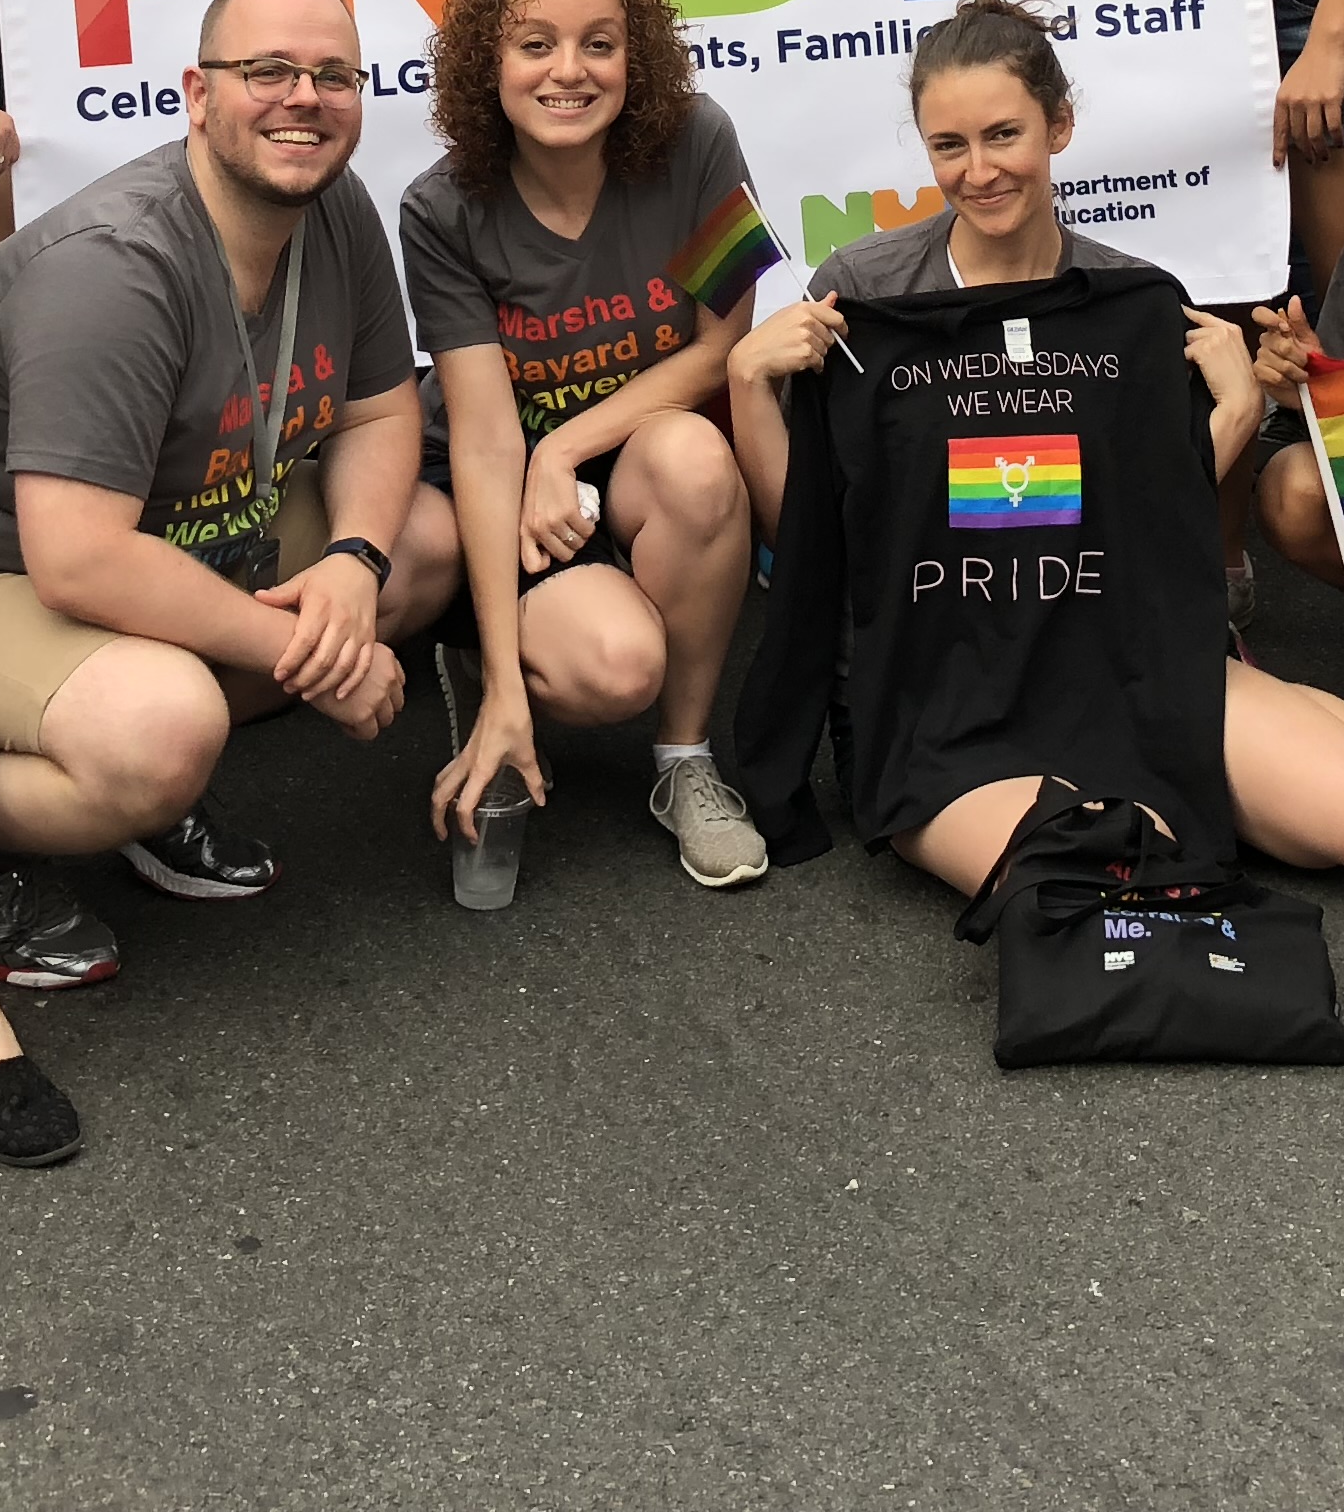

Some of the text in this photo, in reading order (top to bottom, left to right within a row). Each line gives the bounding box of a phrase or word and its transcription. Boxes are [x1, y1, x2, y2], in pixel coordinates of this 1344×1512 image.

[1185, 166, 1210, 187] of
[1055, 201, 1155, 226] ucation
[498, 277, 678, 341] Marsha &
[655, 324, 680, 351] &
[891, 351, 1119, 390] ON WEDNESDAYS
[219, 344, 335, 435] Masa &
[526, 369, 639, 410] arvey
[947, 389, 1074, 416] WE WEAR
[313, 394, 335, 429] &
[913, 551, 1105, 603] PRIDE
[1104, 918, 1152, 938] Me.
